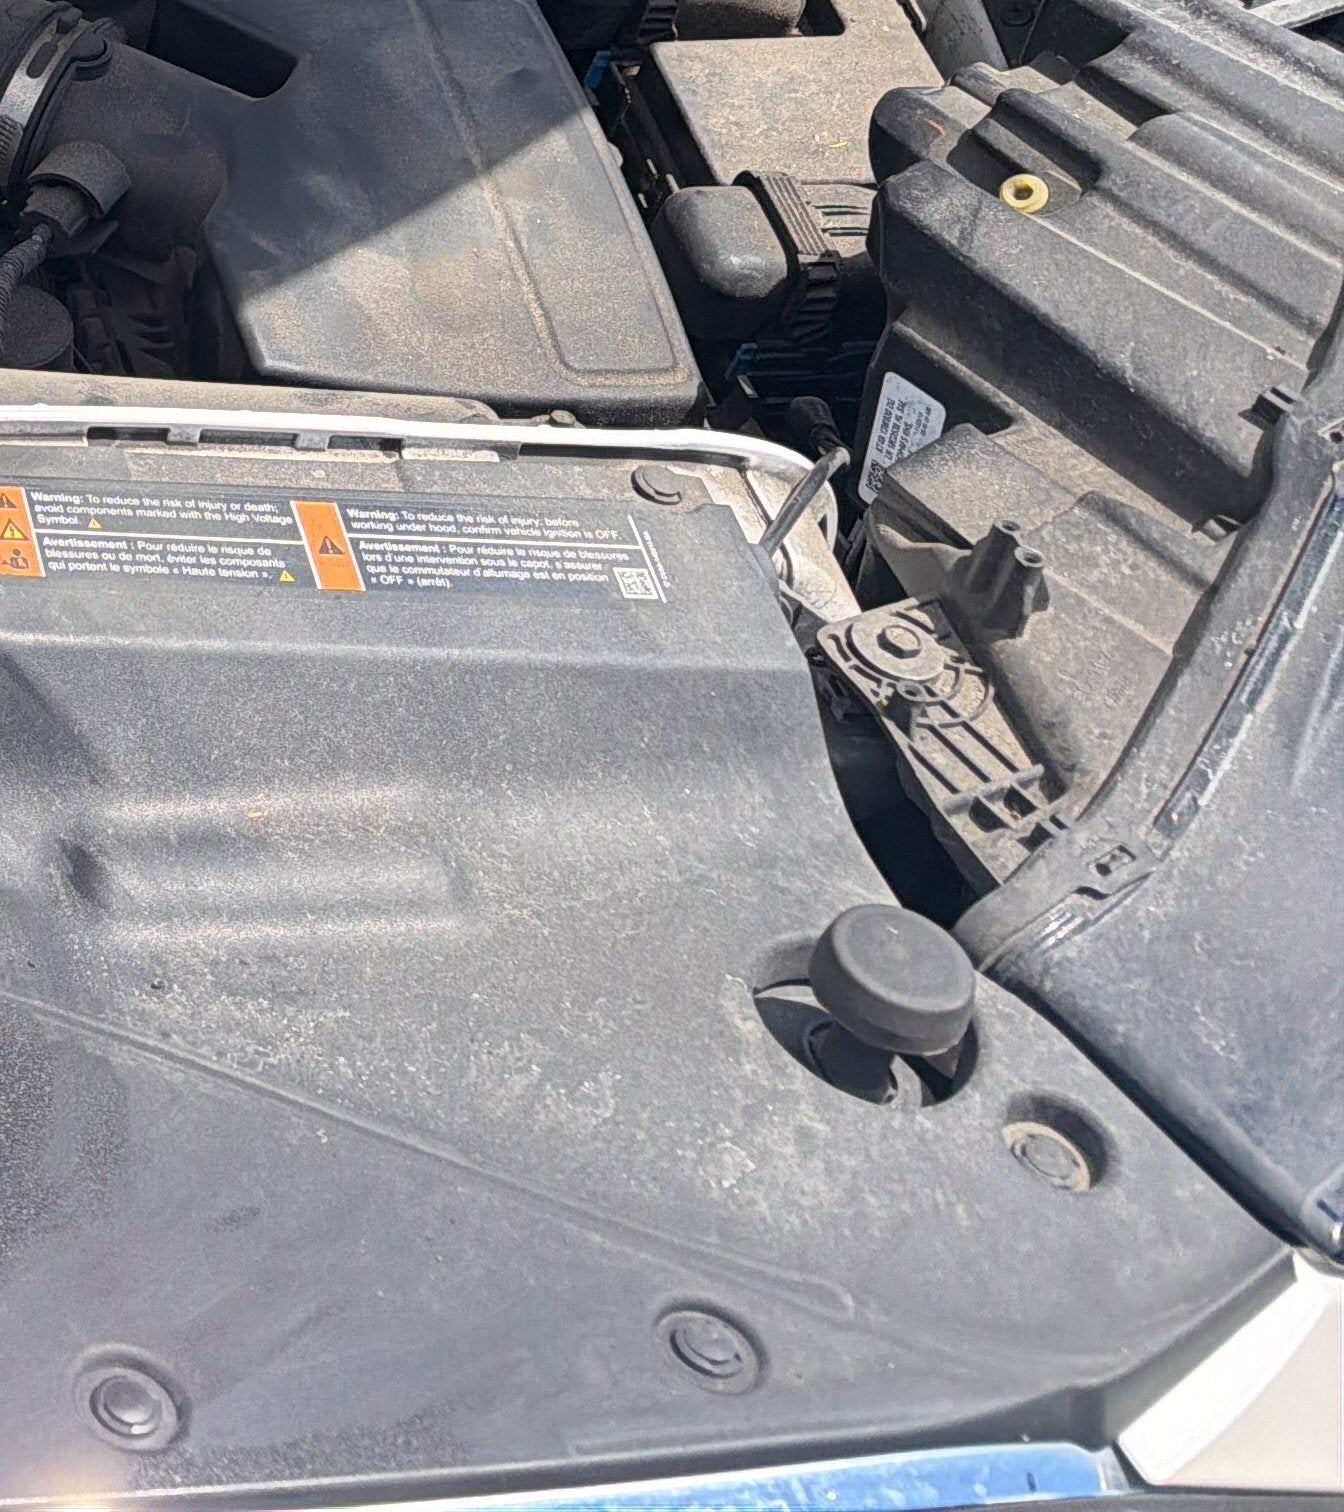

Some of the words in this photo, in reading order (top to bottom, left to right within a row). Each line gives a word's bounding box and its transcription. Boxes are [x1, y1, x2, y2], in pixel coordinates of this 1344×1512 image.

[30, 490, 83, 504] Warning:
[85, 494, 100, 504] To
[102, 494, 139, 505] reduce
[141, 497, 160, 506] the
[162, 497, 182, 507] risk
[184, 498, 195, 508] of
[197, 499, 227, 511] injury
[230, 502, 240, 510] or
[34, 503, 64, 513] avoid
[66, 503, 133, 518] components
[135, 507, 176, 518] marked
[179, 509, 202, 519] with
[204, 511, 221, 520] the
[224, 511, 249, 523] High
[250, 513, 292, 526] Voltage
[346, 507, 399, 521] Warning:
[400, 510, 415, 520] To
[417, 510, 454, 522] reduce
[456, 513, 474, 522] the
[476, 513, 495, 524] risk
[497, 514, 507, 524] of
[544, 516, 579, 527] before
[351, 517, 394, 531] working
[395, 521, 426, 532] under
[461, 524, 501, 535] confirm
[504, 524, 541, 537] vehicle
[543, 527, 581, 540] ignition
[583, 530, 593, 538] is
[42, 534, 128, 551] Avertissement
[136, 540, 163, 551] Pour
[166, 540, 205, 553] réduire
[207, 544, 217, 553] le
[220, 544, 254, 557] risque
[257, 546, 272, 555] de
[359, 539, 440, 555] Avertissement
[448, 544, 474, 555] Pour
[476, 545, 514, 556] réduire
[516, 547, 526, 556] le
[528, 547, 560, 559] risque
[562, 549, 576, 558] de
[579, 549, 629, 562] blessures
[45, 547, 98, 560] blessures
[101, 552, 115, 560] ou
[118, 551, 131, 561] de
[166, 553, 196, 564] éviter
[199, 554, 216, 565] les
[219, 555, 286, 570] composants
[47, 559, 65, 571] qui
[68, 560, 108, 573] portent
[109, 562, 120, 572] le
[122, 561, 169, 577] symbole
[181, 565, 216, 576] Haute
[218, 567, 258, 578] tension
[361, 551, 382, 562] lors
[416, 552, 478, 567] intervention
[480, 556, 506, 567] sous
[507, 557, 518, 567] le
[366, 564, 386, 574] que
[389, 564, 399, 573] le
[401, 564, 470, 578] commutateur
[532, 570, 550, 580] est
[551, 571, 565, 580] en
[567, 570, 609, 585] position
[379, 573, 403, 585] OFF
